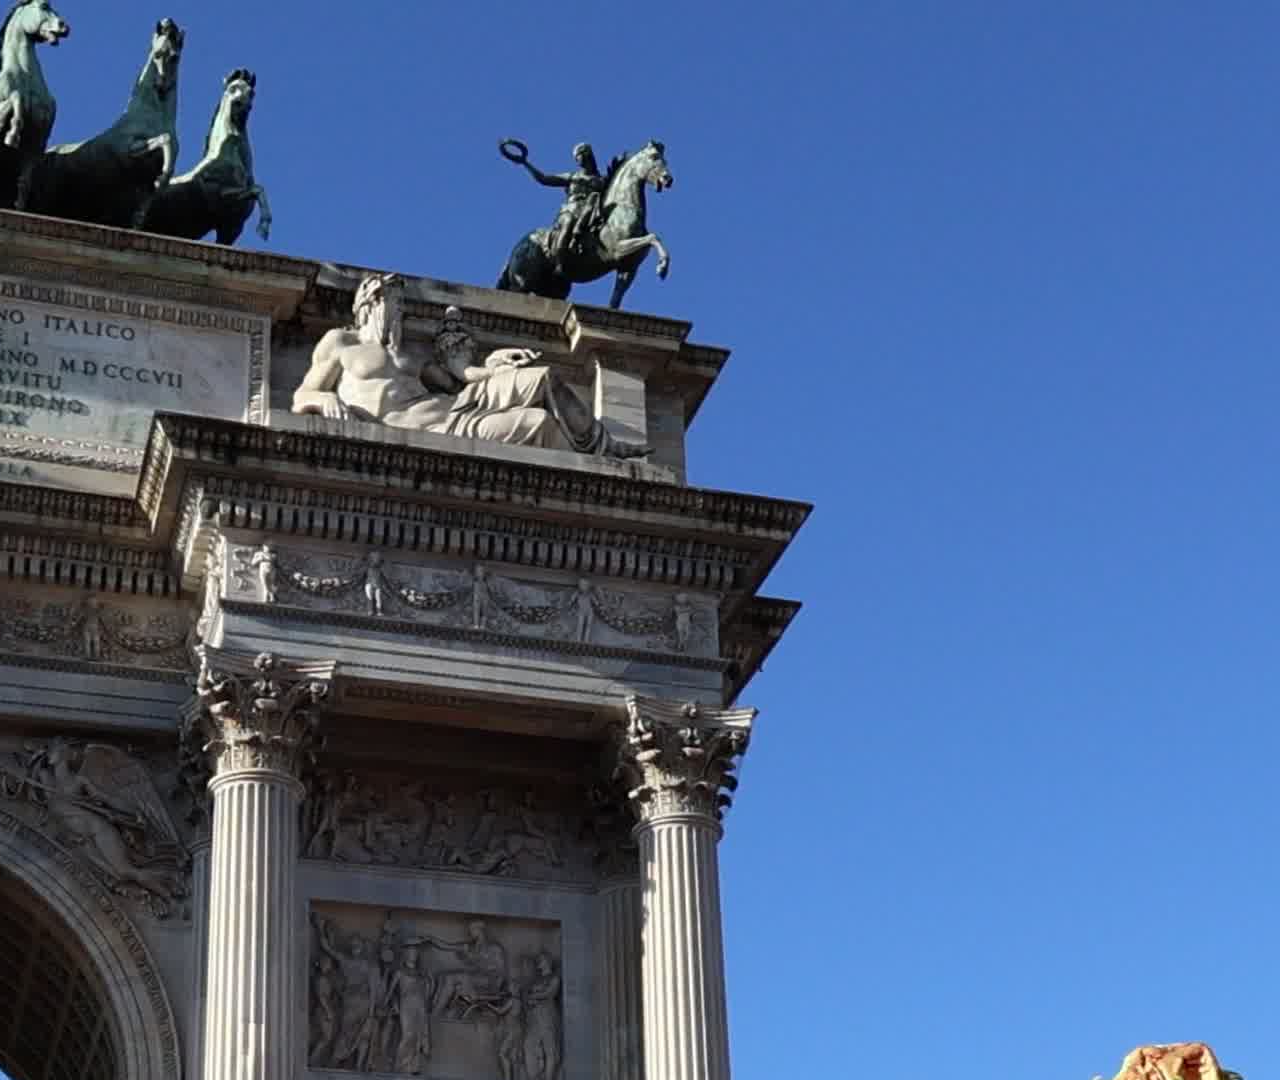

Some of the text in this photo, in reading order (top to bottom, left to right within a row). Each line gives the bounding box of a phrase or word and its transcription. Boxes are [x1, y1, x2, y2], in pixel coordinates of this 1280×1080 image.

[23, 331, 30, 346] I
[44, 315, 135, 341] ITALICO
[59, 357, 183, 389] MDCCCVII
